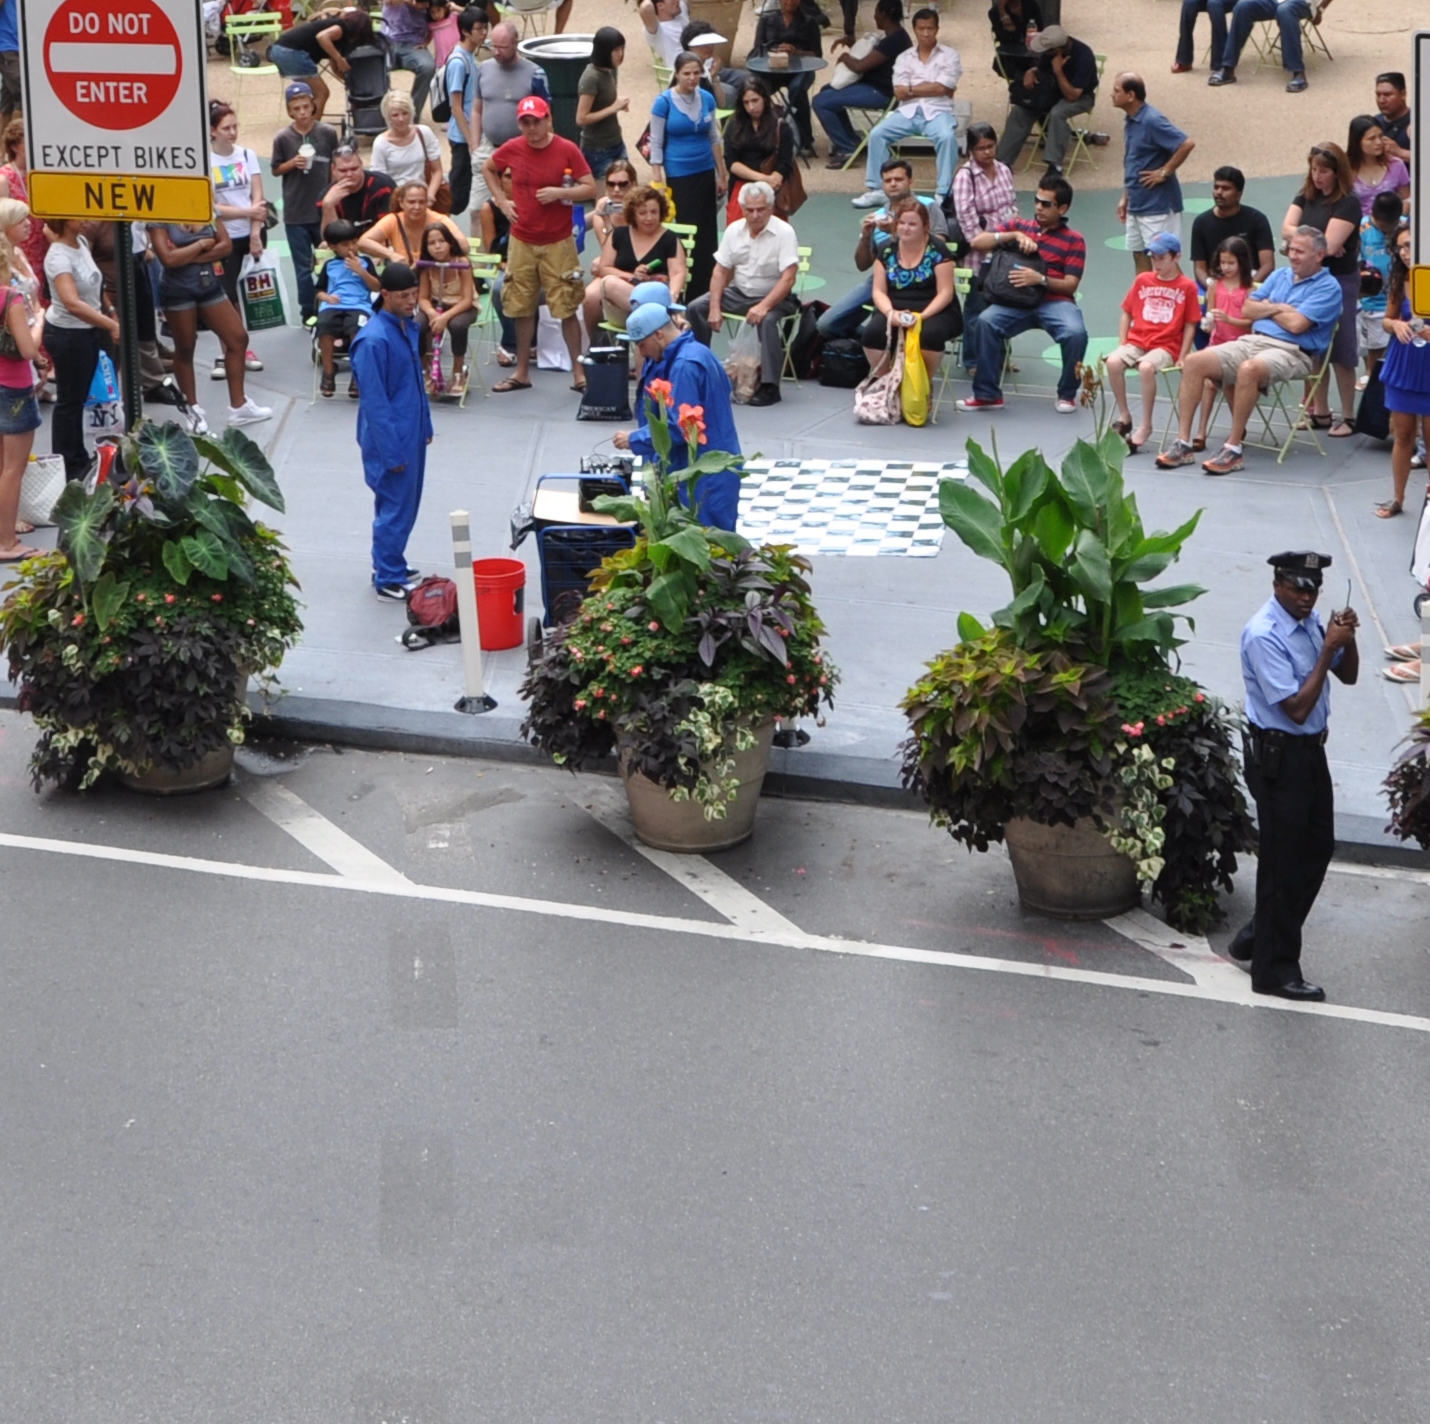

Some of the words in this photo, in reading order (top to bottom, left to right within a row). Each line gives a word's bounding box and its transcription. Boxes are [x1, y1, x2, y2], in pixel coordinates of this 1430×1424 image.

[69, 12, 100, 34] DO
[108, 13, 151, 35] NOT
[76, 81, 148, 104] ENTER
[42, 145, 122, 168] EXCEPT
[134, 146, 197, 169] BIKES
[84, 182, 155, 212] NEW
